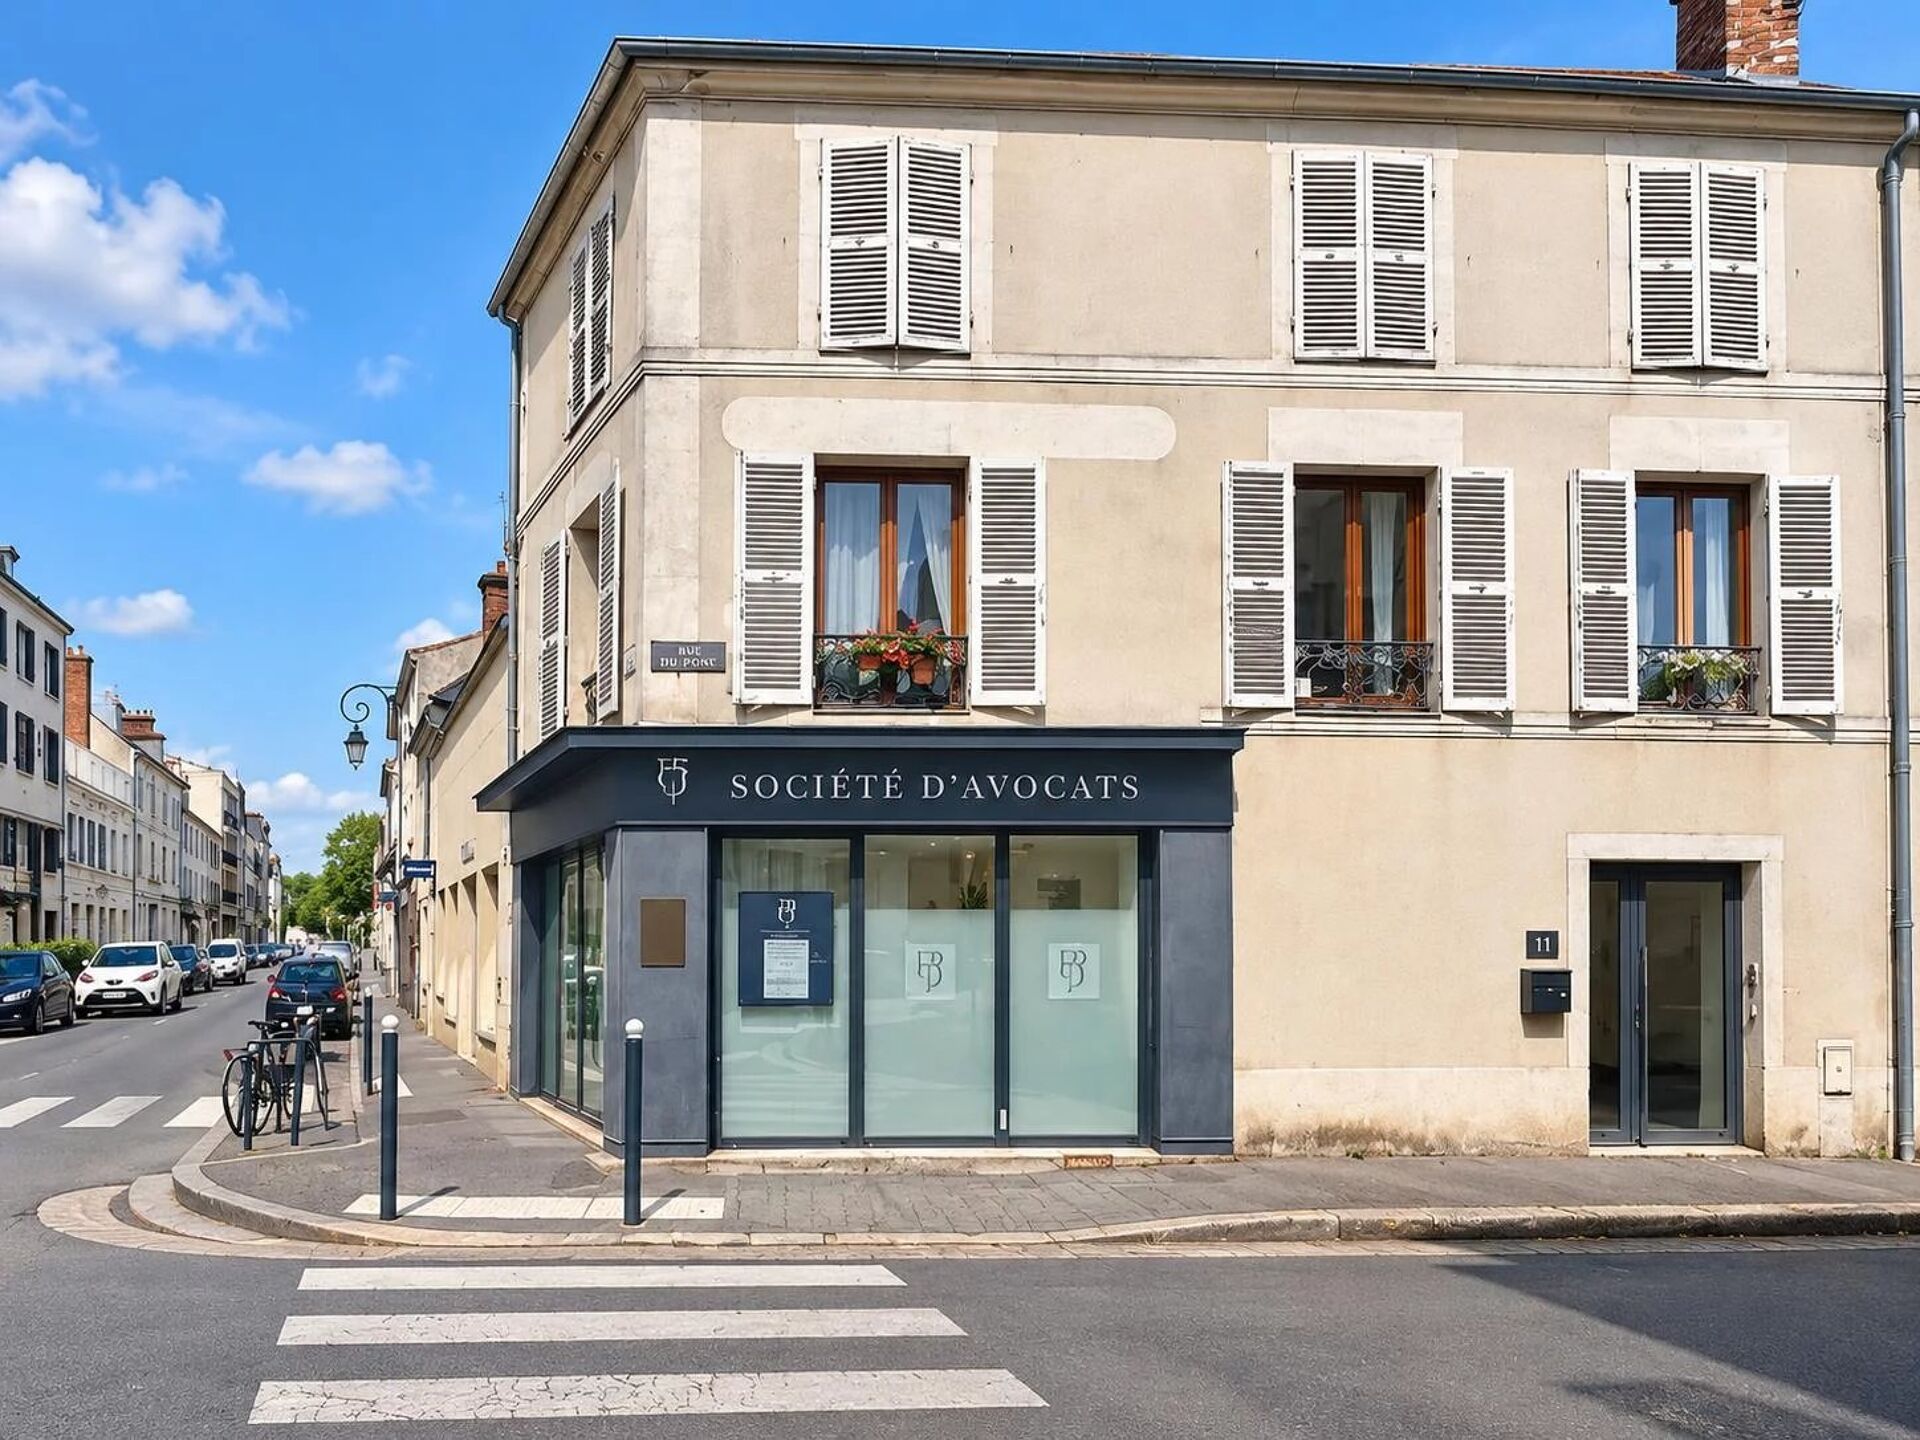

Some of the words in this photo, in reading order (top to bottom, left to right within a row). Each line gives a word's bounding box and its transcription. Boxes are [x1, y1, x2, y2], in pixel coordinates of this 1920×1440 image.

[730, 767, 903, 799] SOCIÉTÉ
[921, 774, 1139, 799] D’AVOCATS
[1535, 936, 1550, 952] 11
